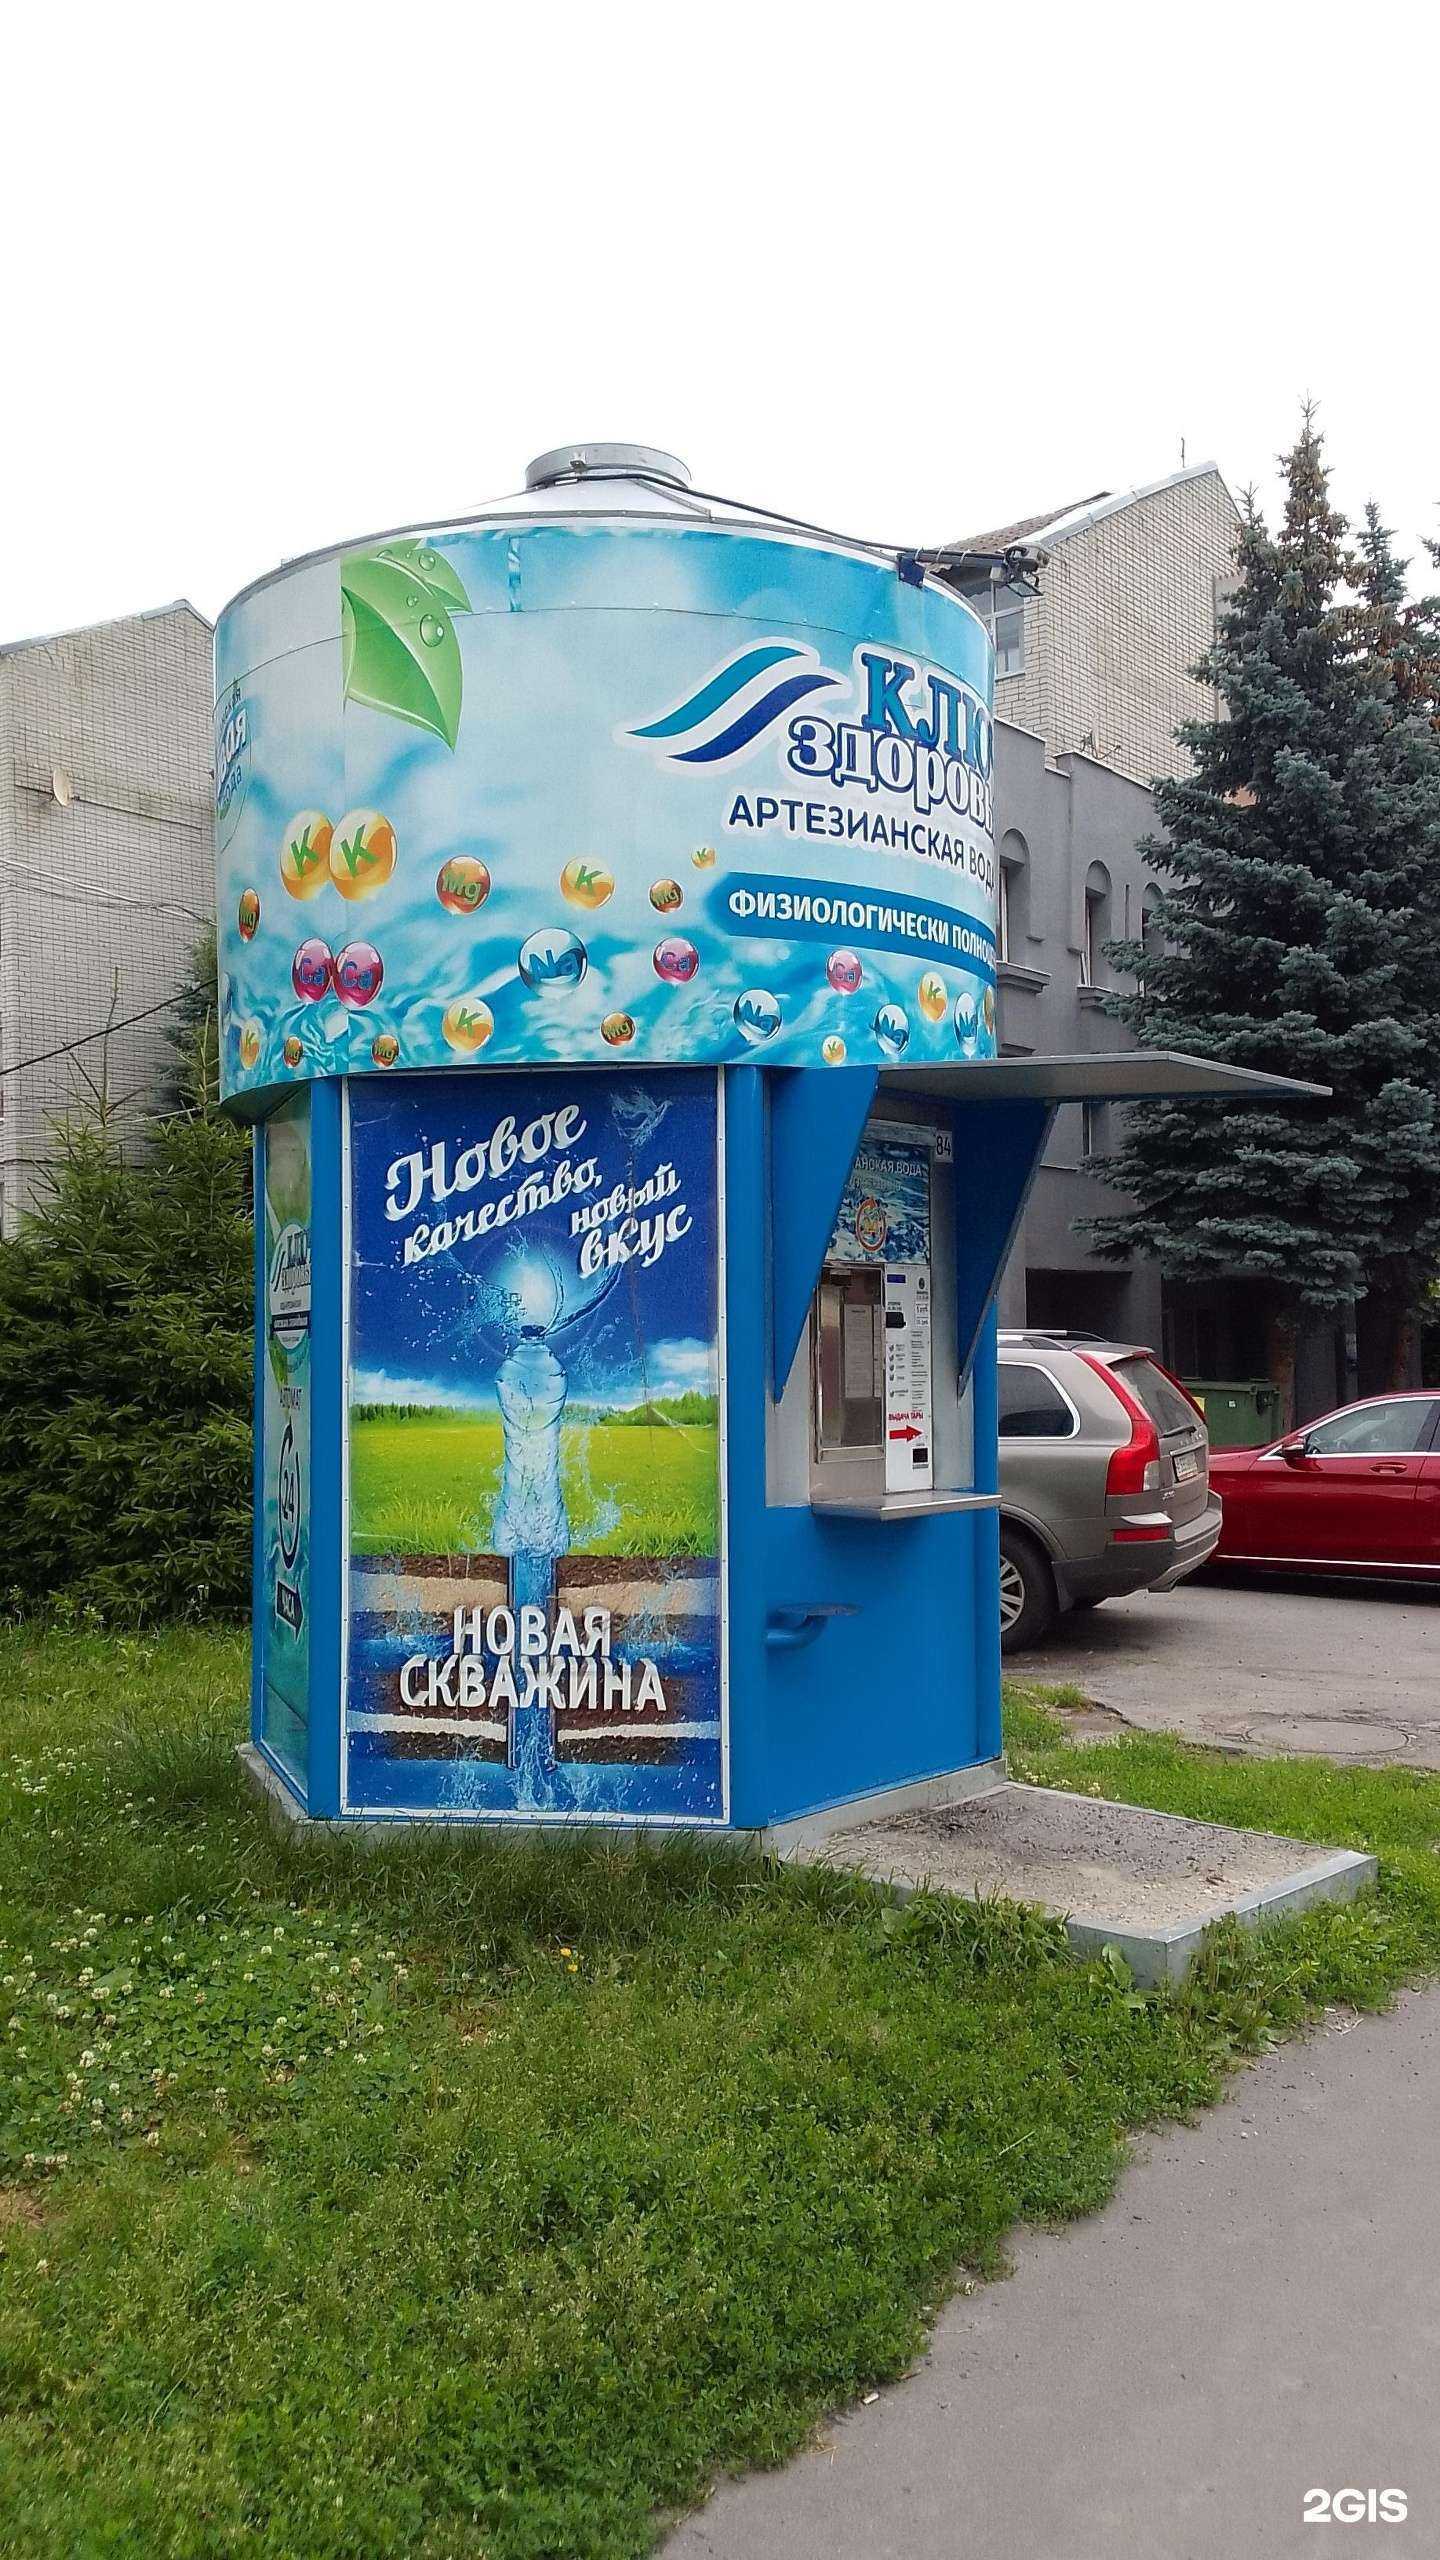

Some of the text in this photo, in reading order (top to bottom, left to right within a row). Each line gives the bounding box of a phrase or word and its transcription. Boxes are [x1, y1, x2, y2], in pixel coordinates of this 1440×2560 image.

[728, 795, 965, 869] АРТЕЗИАНСКАЯ
[728, 889, 994, 969] ФИЗИОЛОГИЧЕСКИ ПОЛНО
[527, 949, 582, 978] Na
[384, 1104, 588, 1222] Новое
[896, 1160, 922, 1177] ВОДА
[936, 1135, 951, 1156] 84
[402, 1156, 603, 1267] качество,
[569, 1162, 682, 1238] новый
[579, 1204, 693, 1280] вкус
[910, 1411, 924, 1420] ТАРЫ
[453, 1604, 612, 1657] НОВАЯ
[400, 1653, 667, 1712] СКВАЖИНА
